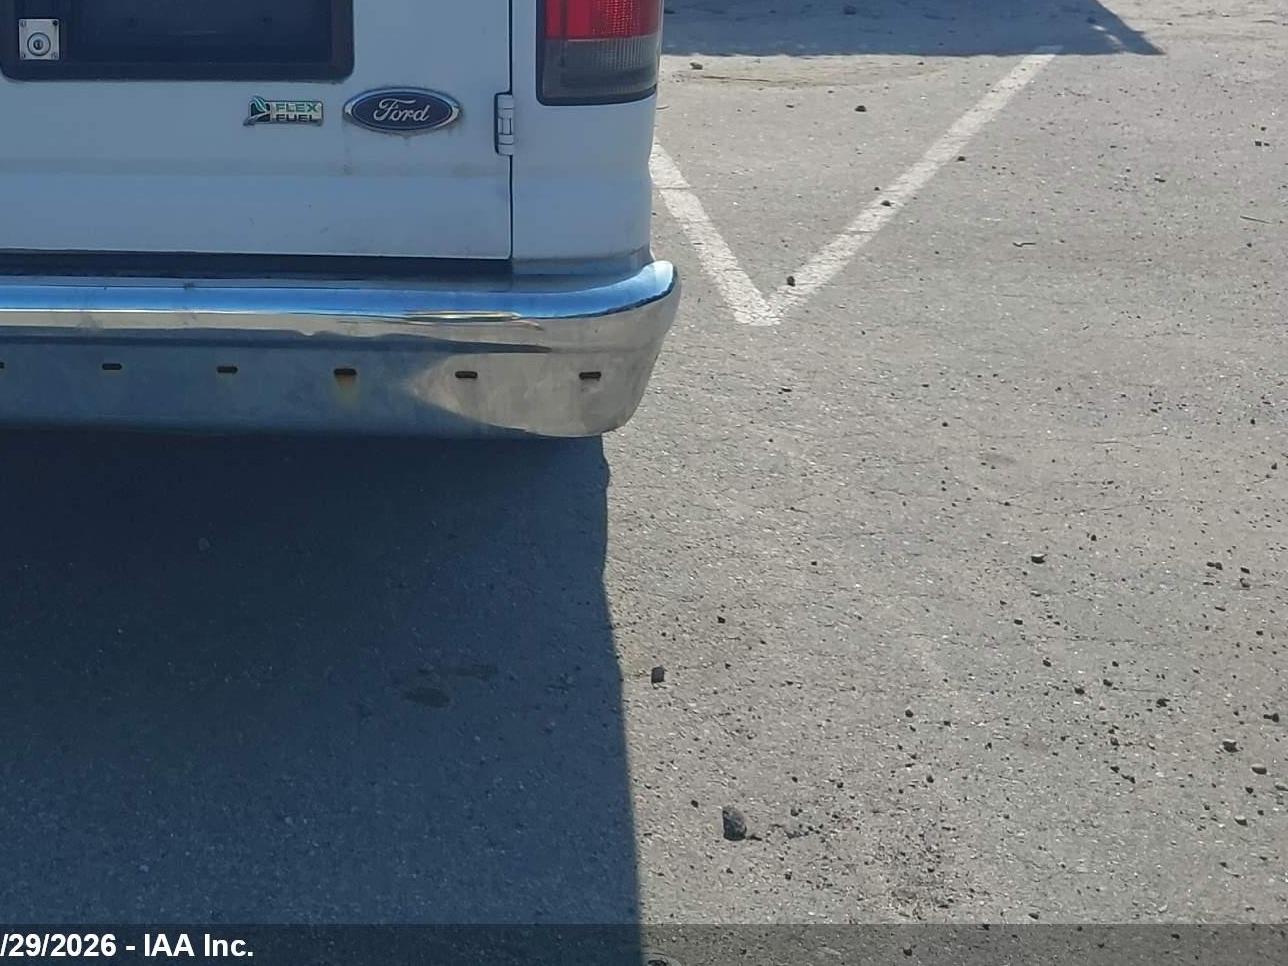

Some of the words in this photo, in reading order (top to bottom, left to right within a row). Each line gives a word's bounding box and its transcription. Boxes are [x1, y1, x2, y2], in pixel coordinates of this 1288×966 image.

[275, 102, 318, 113] FLEX
[373, 97, 430, 122] Ford
[275, 114, 318, 122] FUEL
